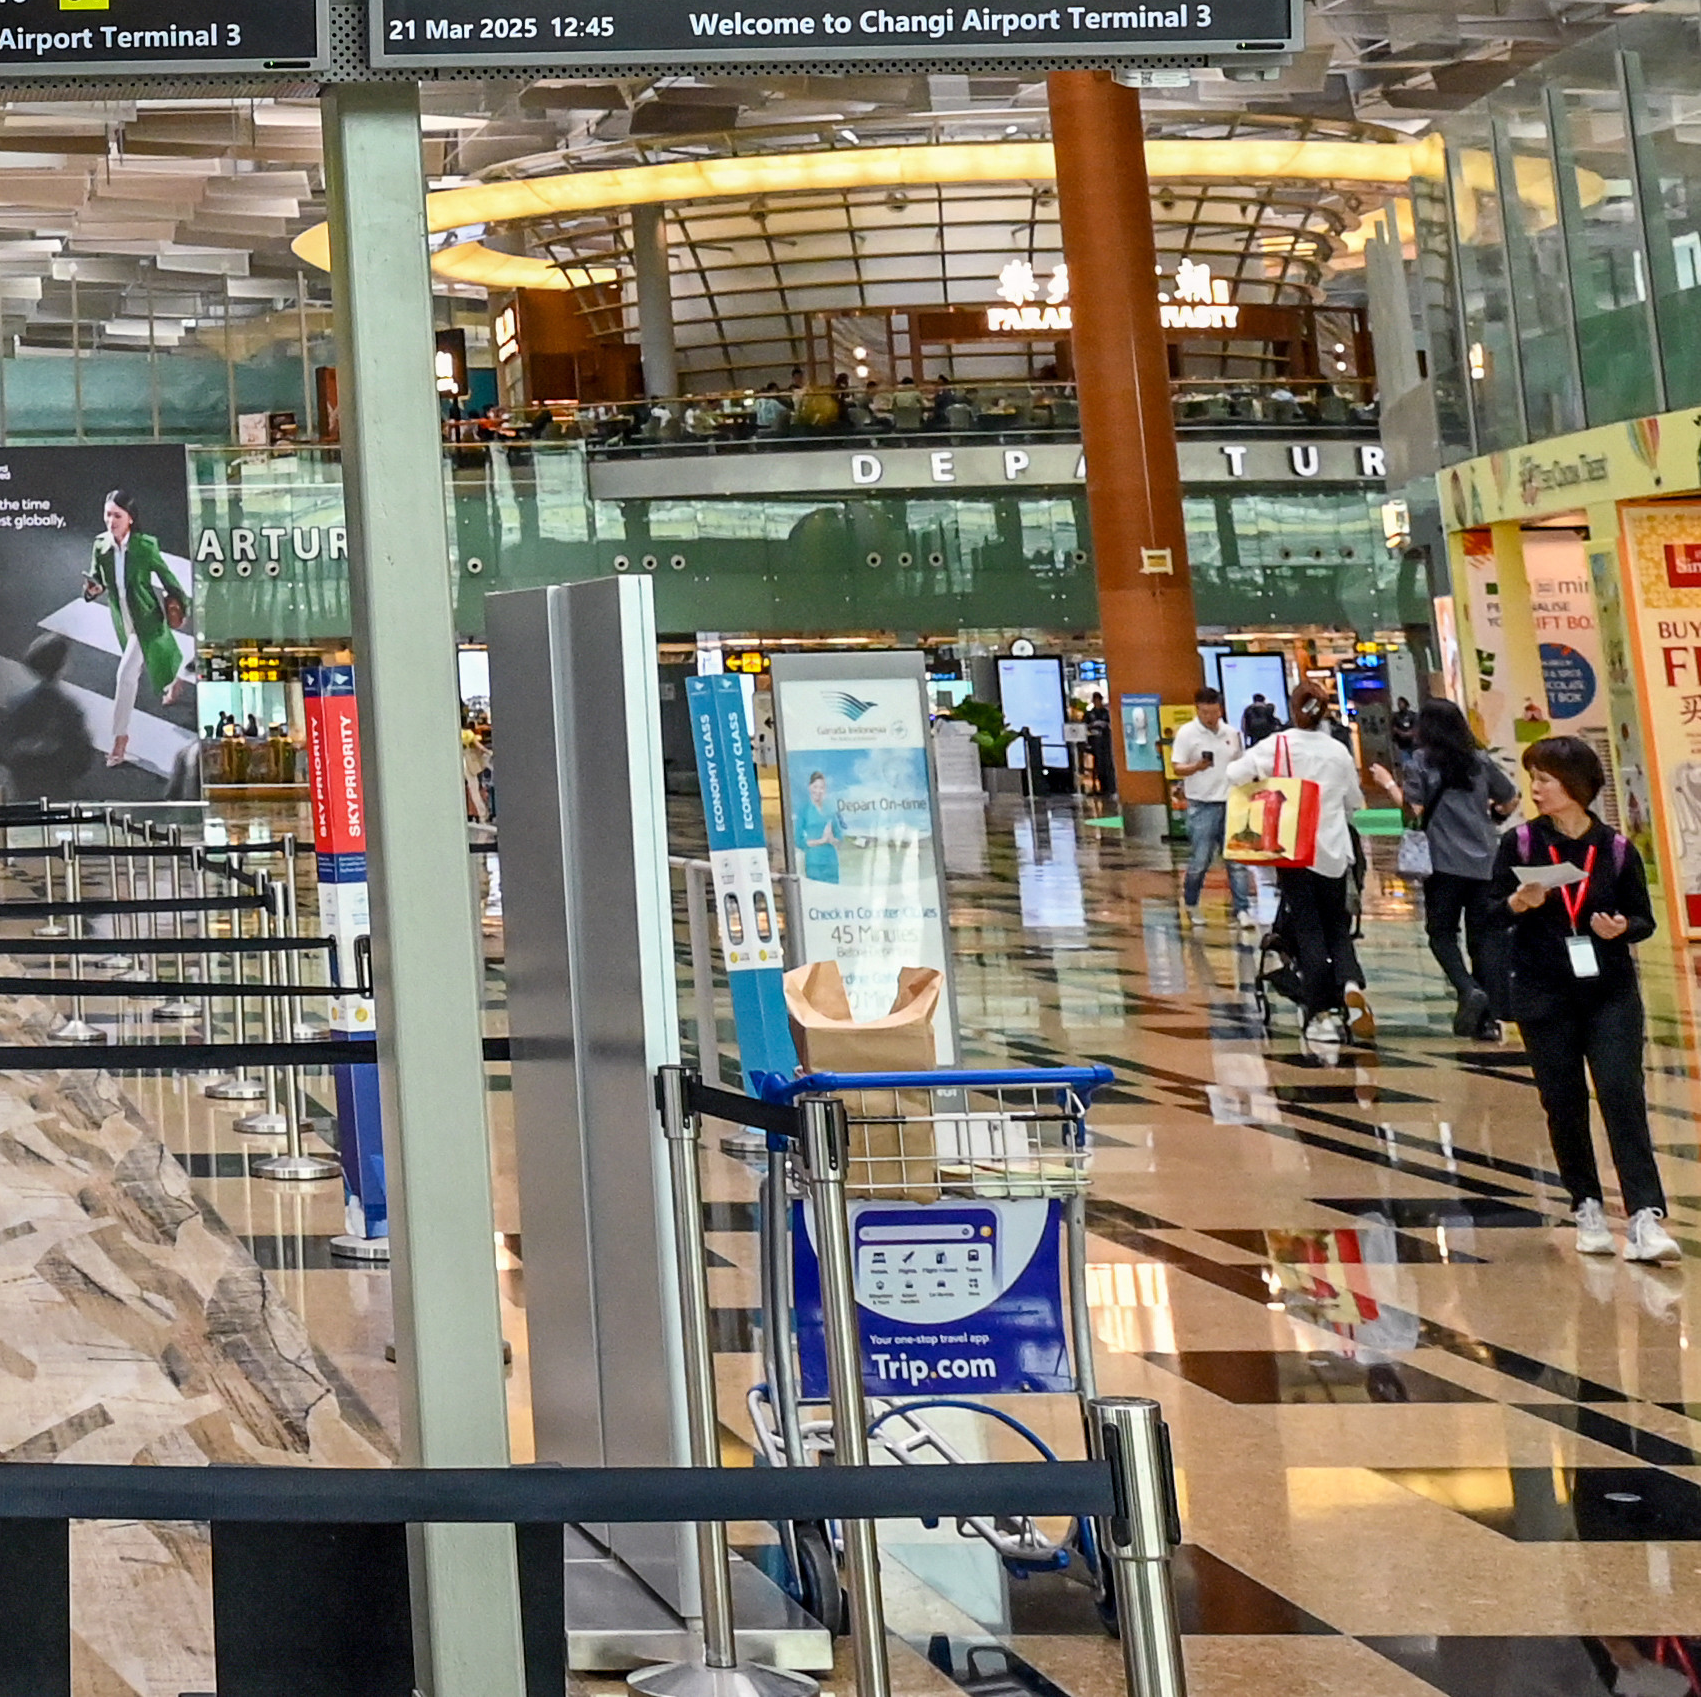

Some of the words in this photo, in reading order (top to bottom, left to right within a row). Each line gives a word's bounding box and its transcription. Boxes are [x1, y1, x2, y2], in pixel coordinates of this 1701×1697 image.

[0, 498, 19, 510] the
[22, 498, 50, 510] time
[14, 514, 66, 529] globally,
[1658, 621, 1701, 639] BUY
[700, 713, 715, 757] CLASS
[728, 712, 743, 756] CLASS
[707, 760, 726, 832] ECONOMY
[734, 757, 754, 830] ECONOMY
[837, 798, 875, 813] Depart
[881, 797, 927, 809] On-time
[809, 908, 841, 920] Check
[844, 908, 854, 919] in
[831, 925, 854, 944] 45
[870, 1335, 891, 1344] Your
[895, 1335, 938, 1345] one-stop
[940, 1333, 967, 1343] travel
[970, 1335, 989, 1345] app
[871, 1353, 996, 1386] Trip.com
